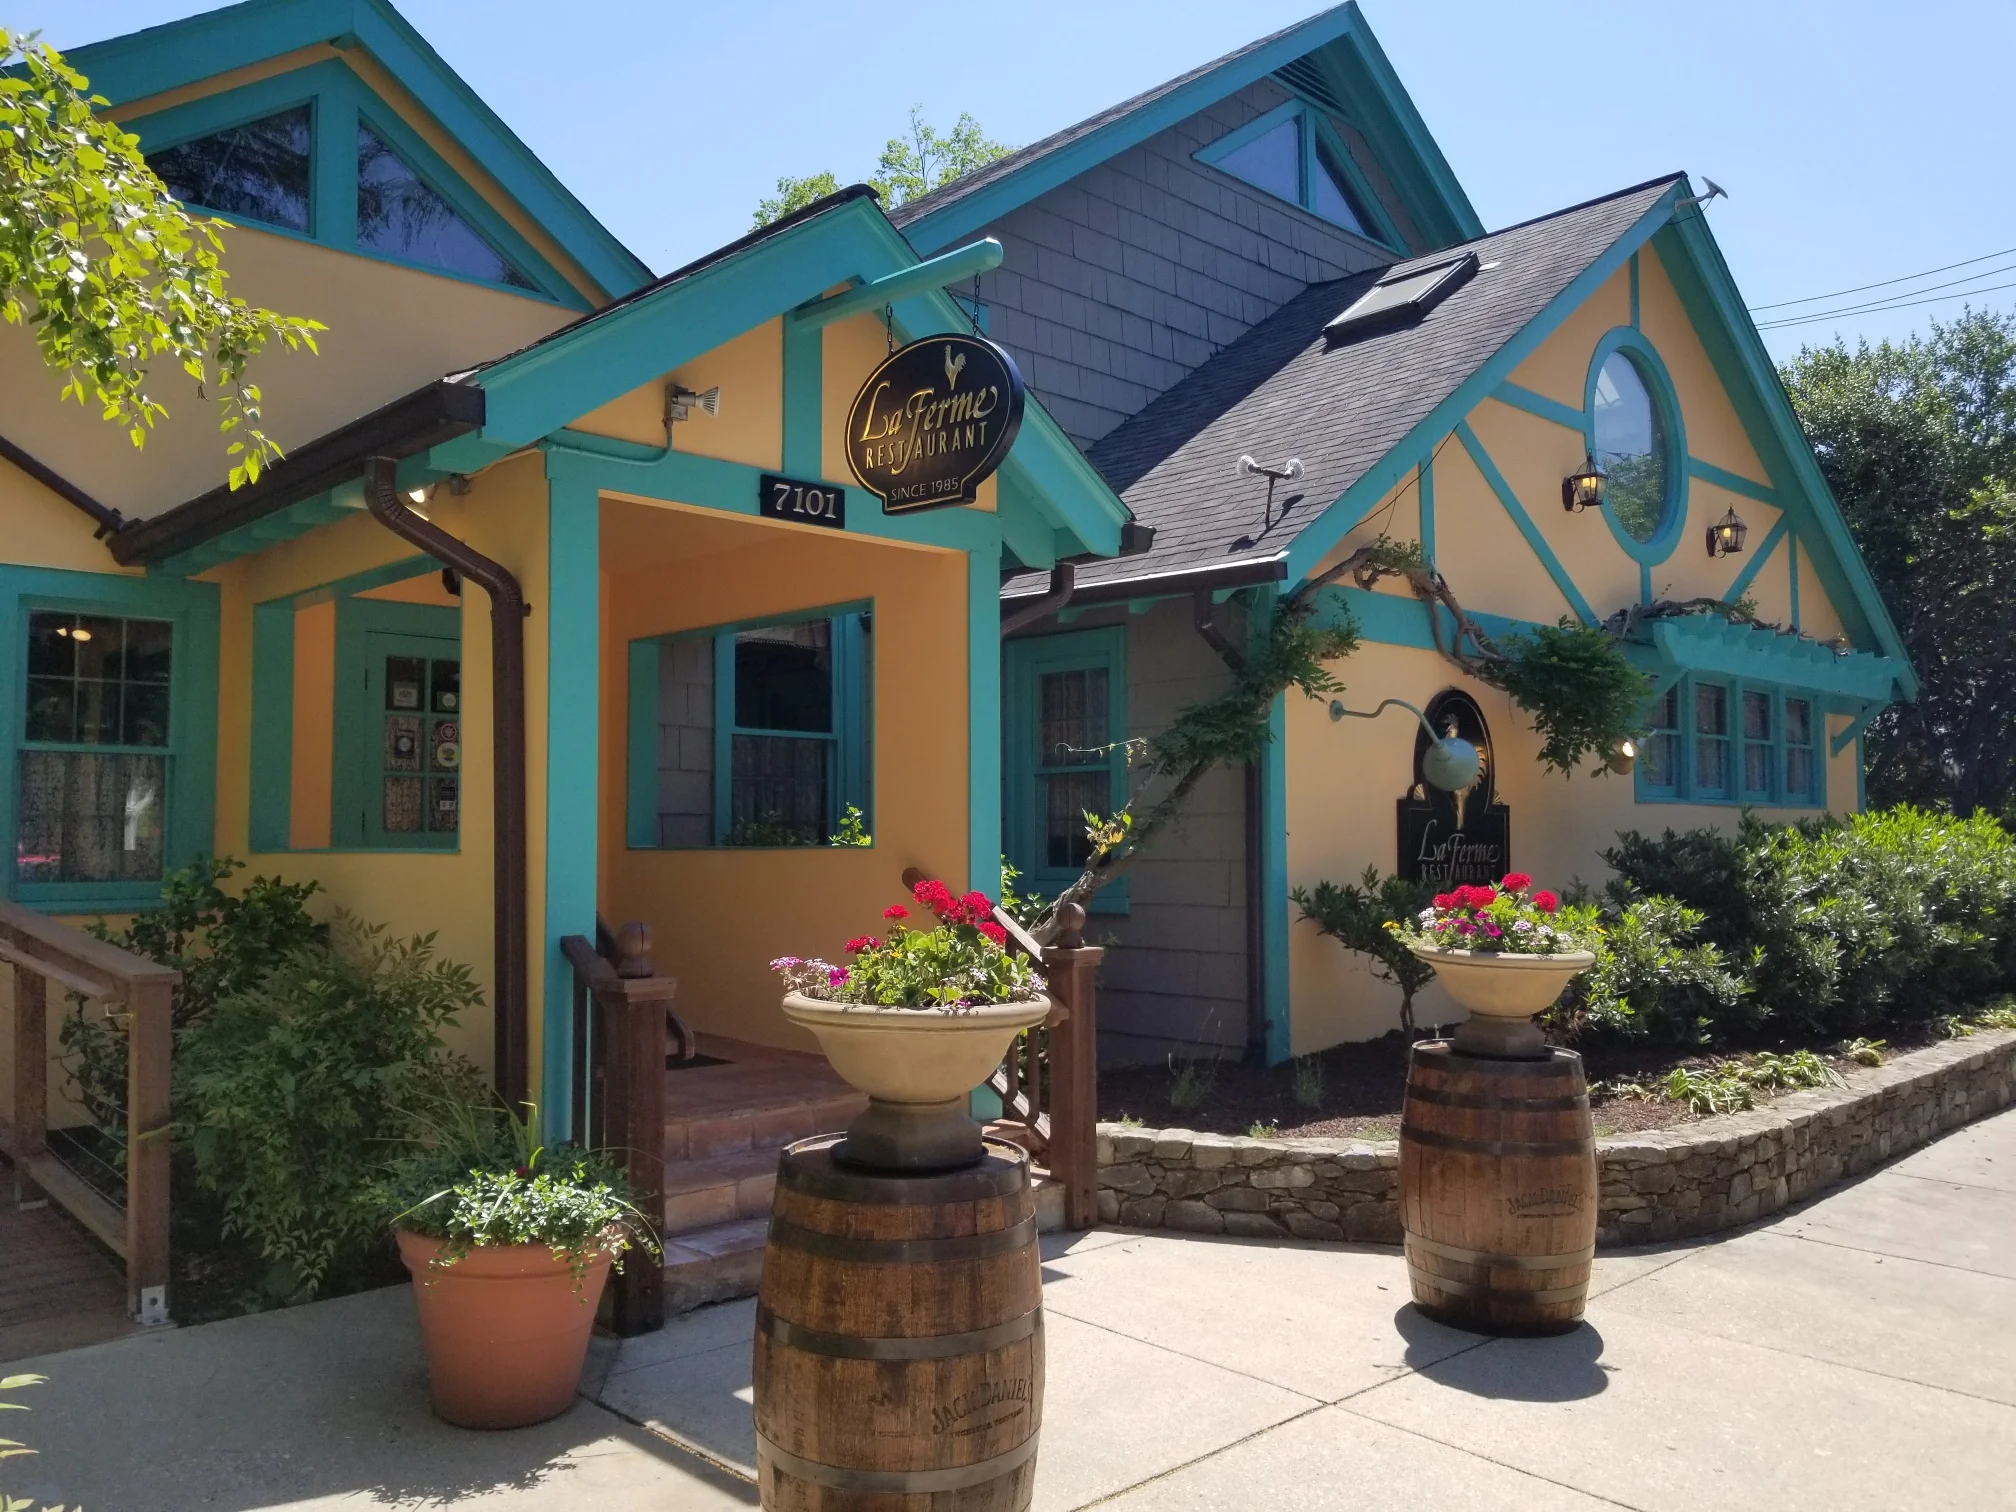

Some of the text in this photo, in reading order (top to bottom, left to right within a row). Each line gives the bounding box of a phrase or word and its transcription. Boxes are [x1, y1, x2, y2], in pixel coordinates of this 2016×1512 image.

[859, 380, 998, 476] La Ferme
[865, 421, 988, 470] RESTAURANT
[773, 482, 837, 519] 7101
[891, 477, 960, 501] SINCE 1985
[1417, 819, 1500, 881] La Ferme
[1421, 864, 1496, 881] RESTAURANT
[931, 1390, 979, 1435] JACK
